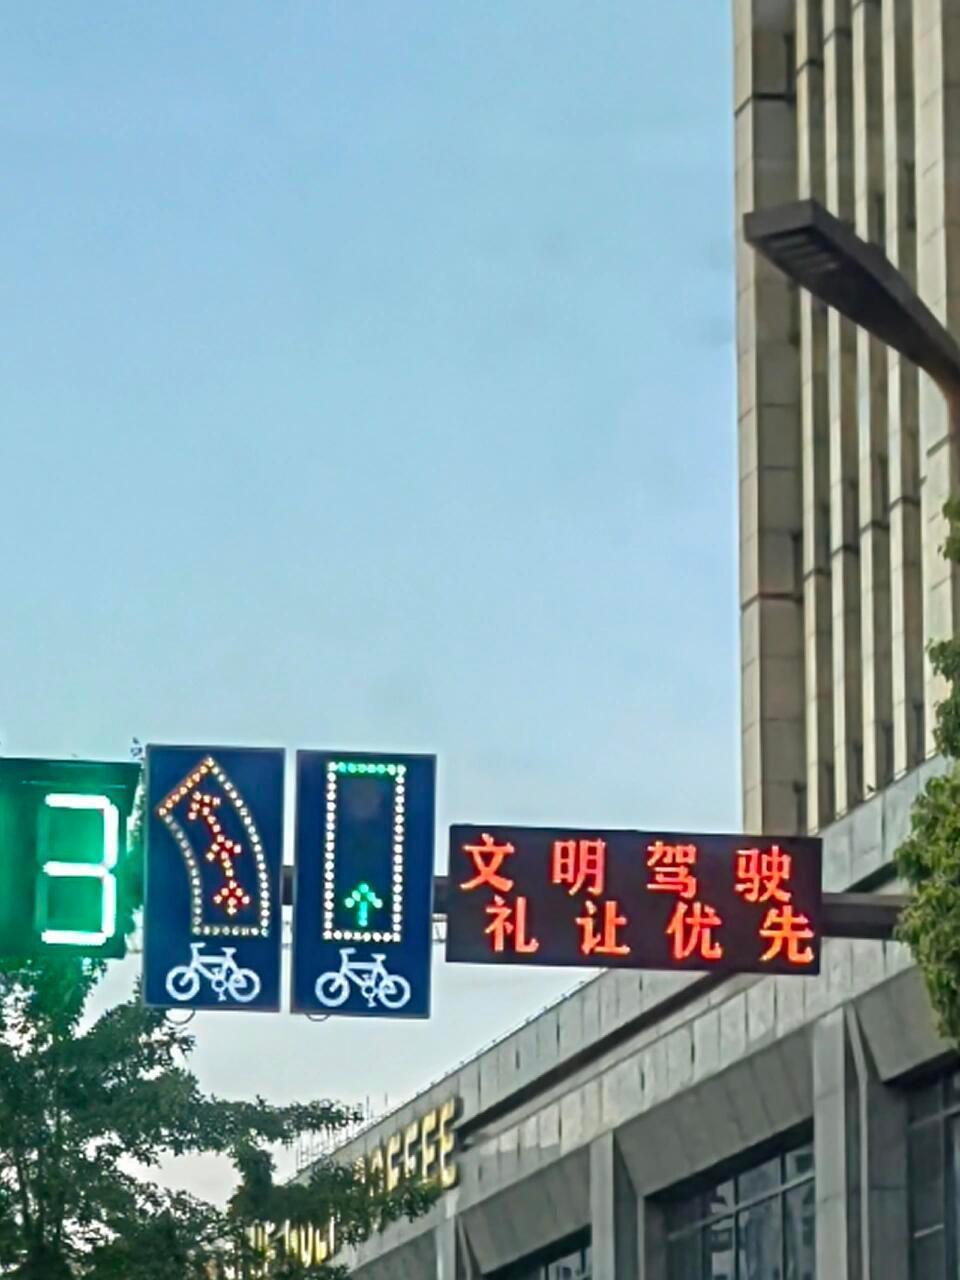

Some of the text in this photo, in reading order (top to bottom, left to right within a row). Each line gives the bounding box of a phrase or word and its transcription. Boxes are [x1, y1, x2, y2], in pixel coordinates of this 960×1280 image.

[460, 833, 792, 904] 文明驾驶
[484, 896, 814, 964] 礼让优先
